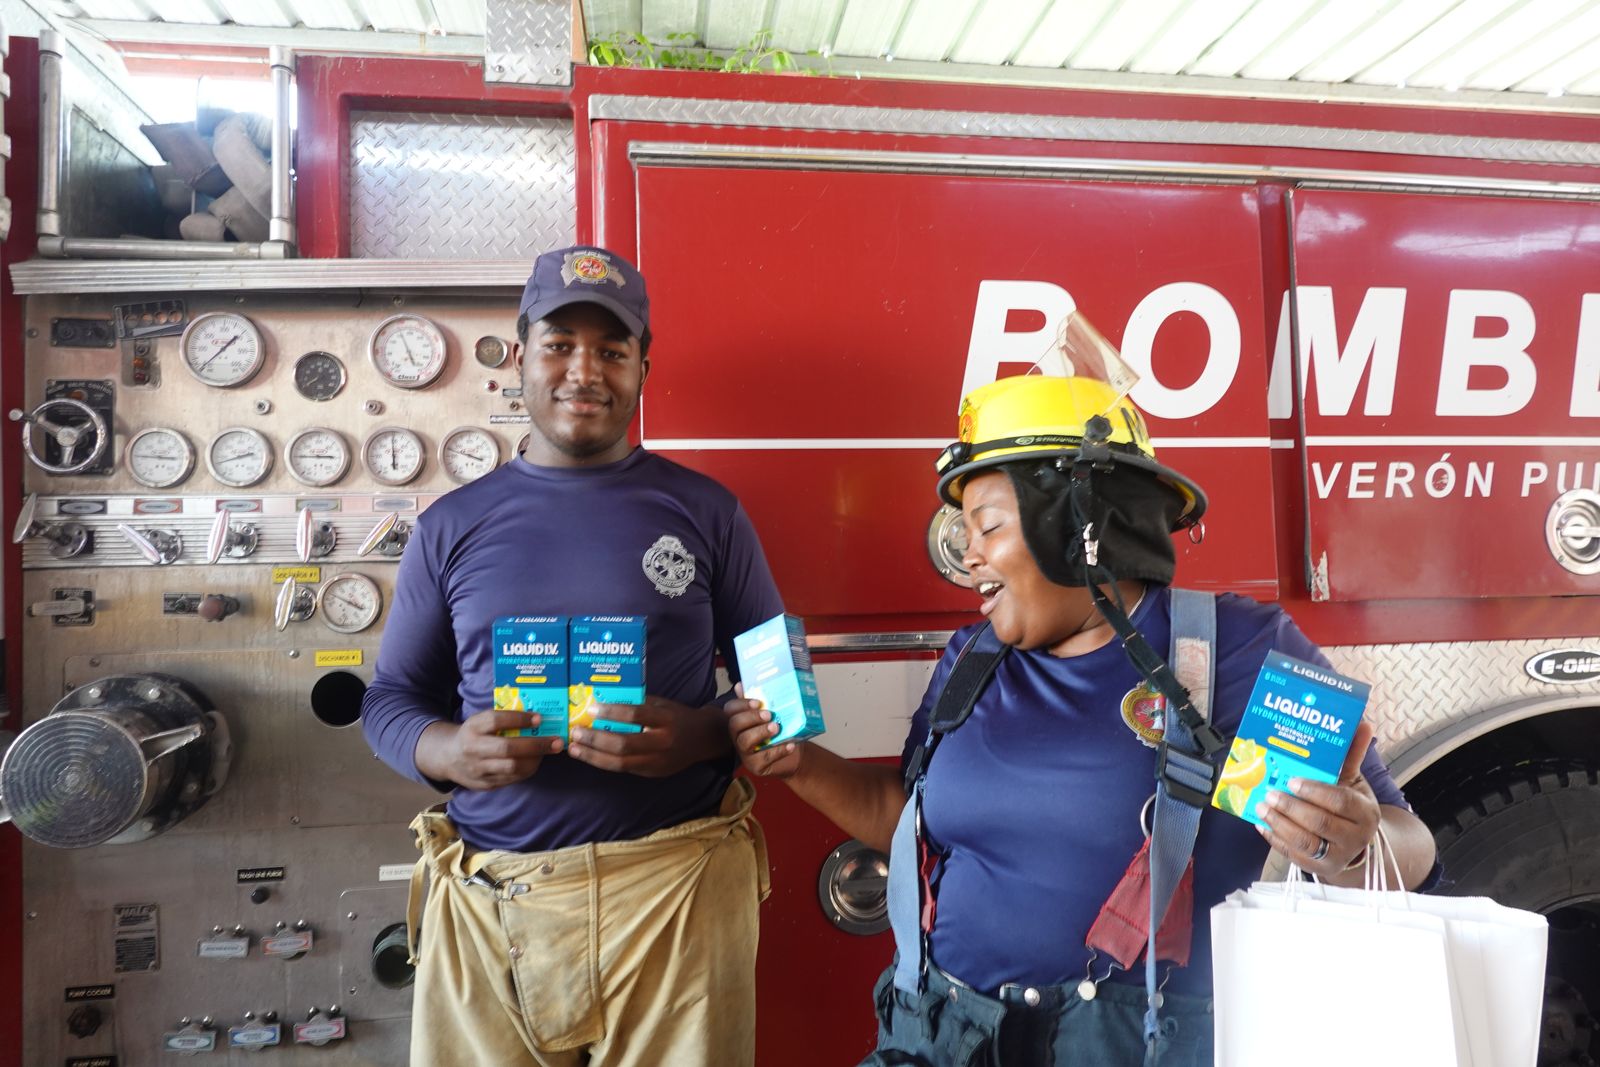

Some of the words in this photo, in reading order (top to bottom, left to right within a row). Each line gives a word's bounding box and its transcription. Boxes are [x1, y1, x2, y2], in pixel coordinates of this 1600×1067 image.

[1312, 453, 1495, 499] VERÓN
[1521, 462, 1600, 498] PU
[503, 642, 544, 656] LIQUID
[578, 641, 619, 655] LIQUID
[1292, 665, 1338, 686] LIQUID
[1251, 705, 1297, 729] HYDRATION
[1296, 722, 1345, 747] MULTIPLIER
[1263, 692, 1322, 725] LIQUID
[1320, 714, 1344, 734] I.V.
